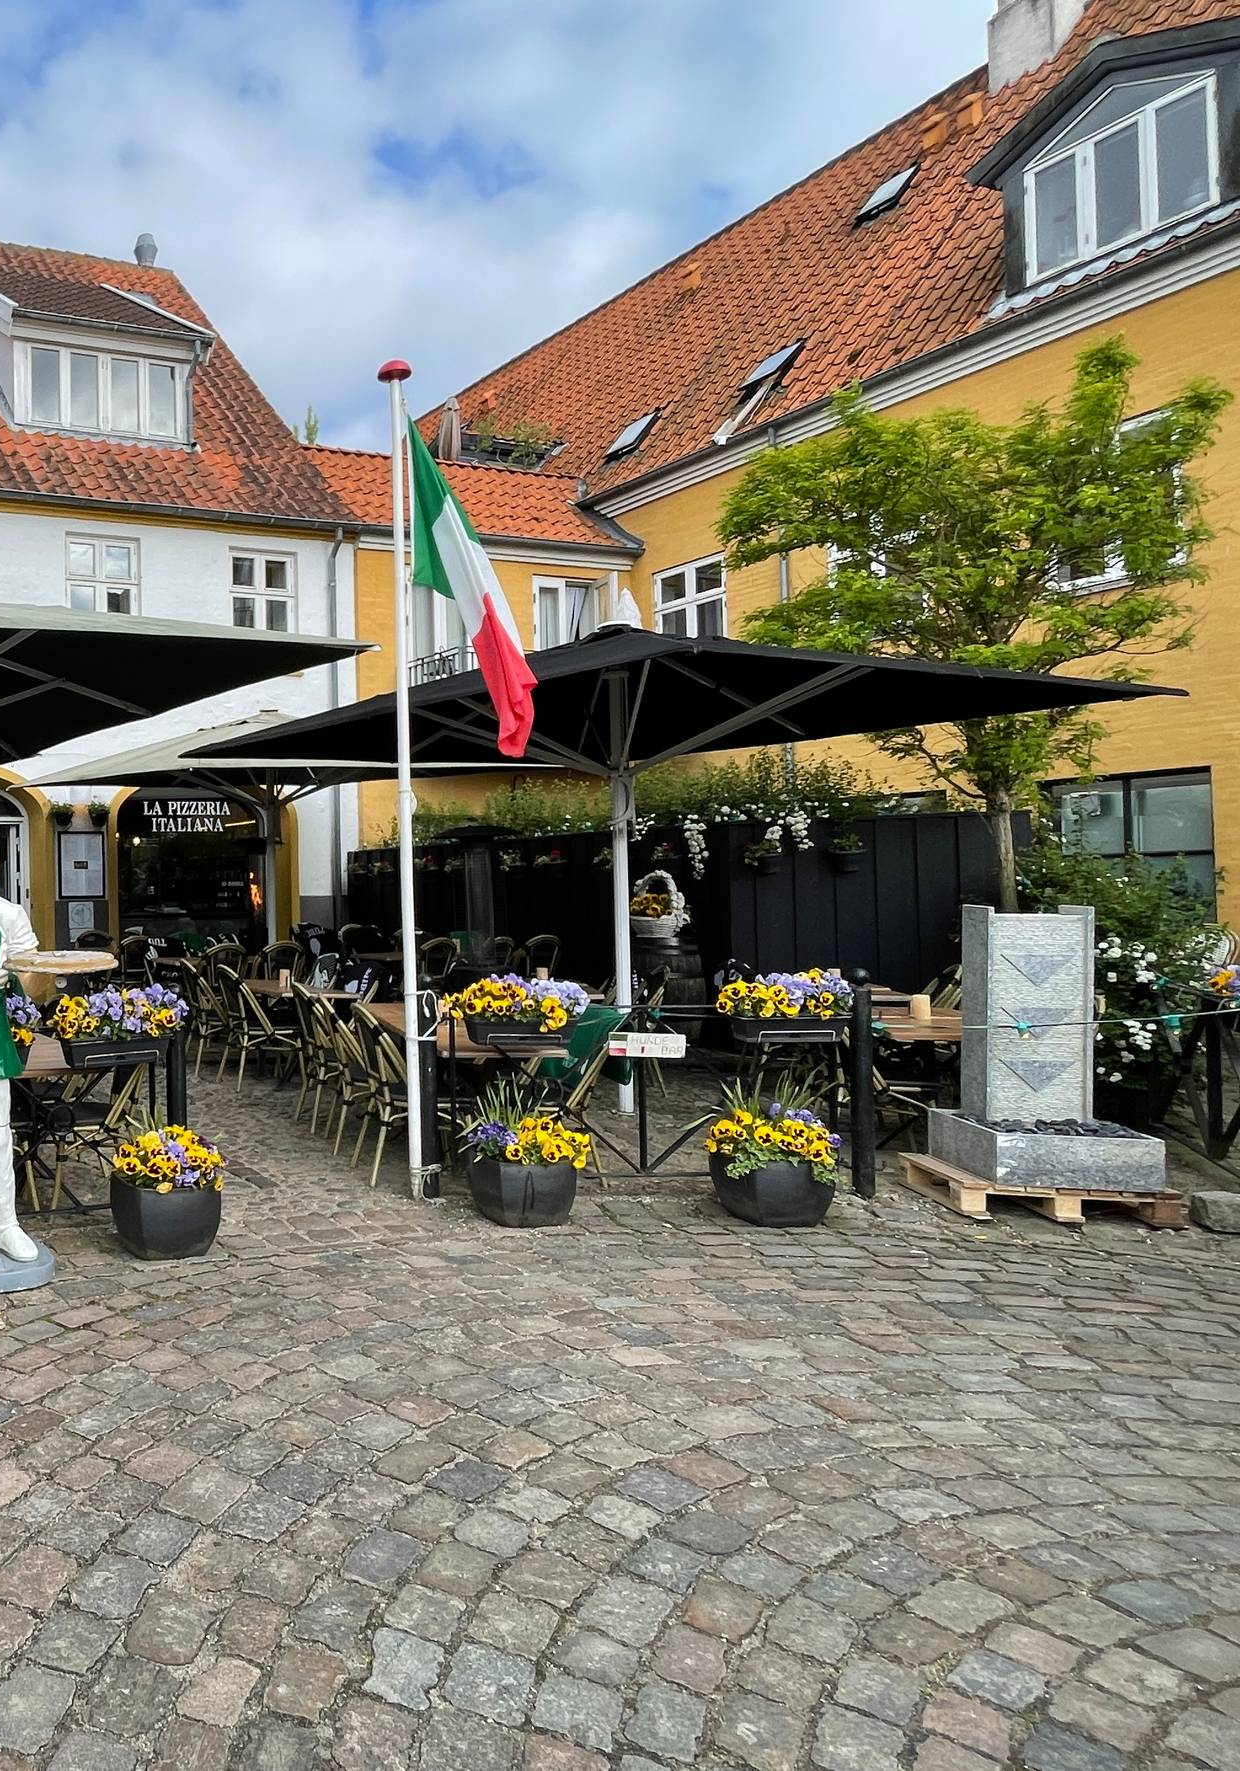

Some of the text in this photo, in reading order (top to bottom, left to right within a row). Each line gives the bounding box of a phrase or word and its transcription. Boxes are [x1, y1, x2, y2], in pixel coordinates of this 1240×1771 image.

[143, 801, 231, 816] LA PIZZERIA
[151, 817, 224, 832] ITALIANA
